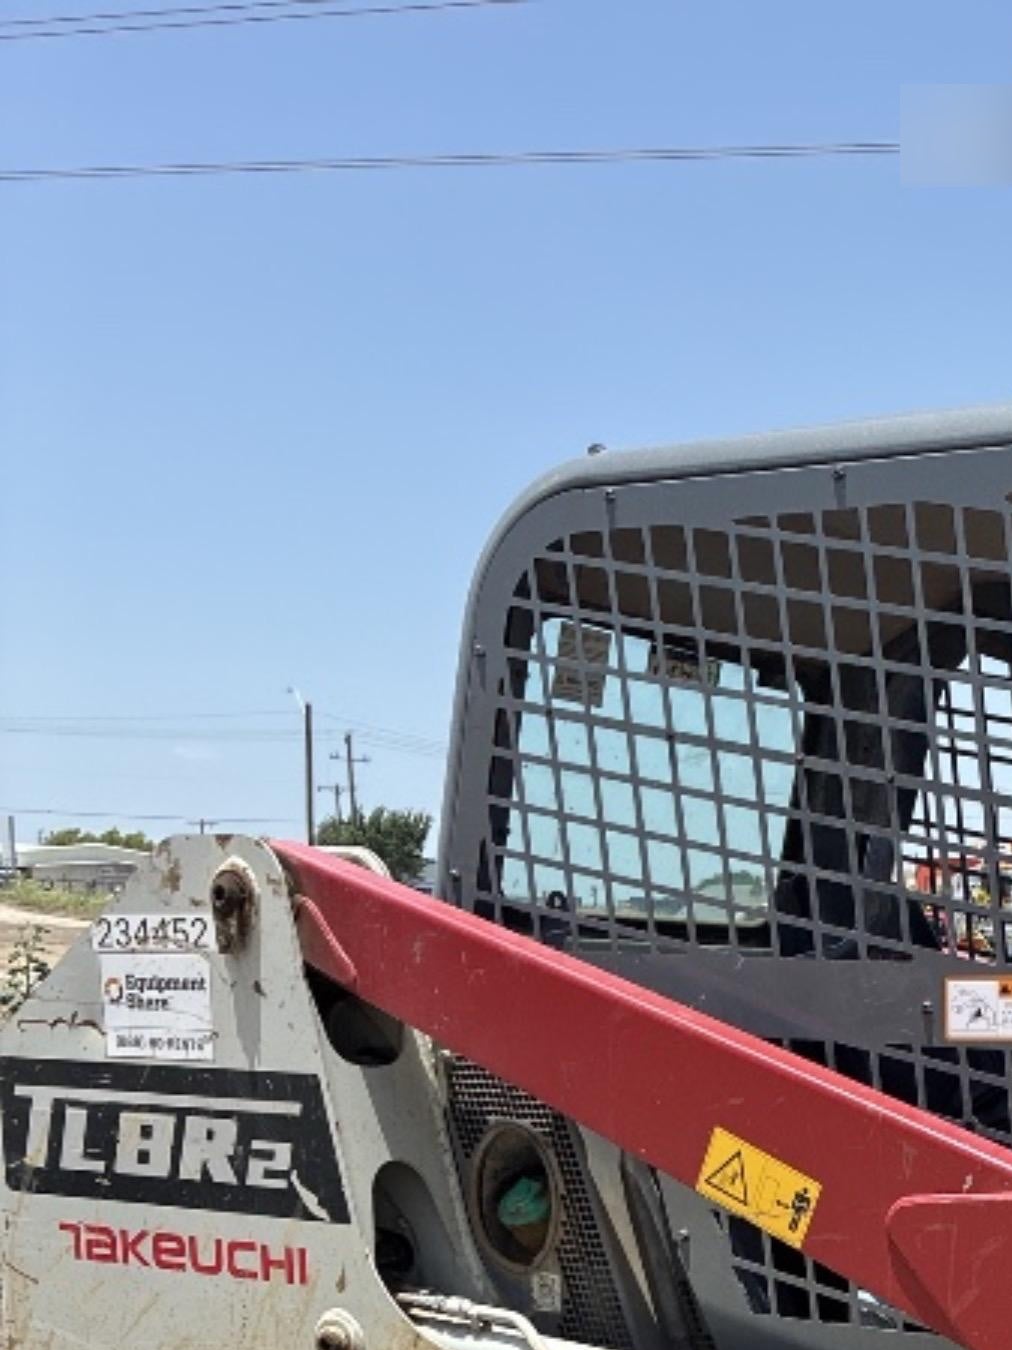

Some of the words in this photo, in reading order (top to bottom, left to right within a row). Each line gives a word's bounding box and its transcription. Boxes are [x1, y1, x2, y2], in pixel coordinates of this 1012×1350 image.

[97, 917, 209, 949] 234452
[124, 974, 207, 993] Equipment
[13, 1084, 303, 1190] TL8R2
